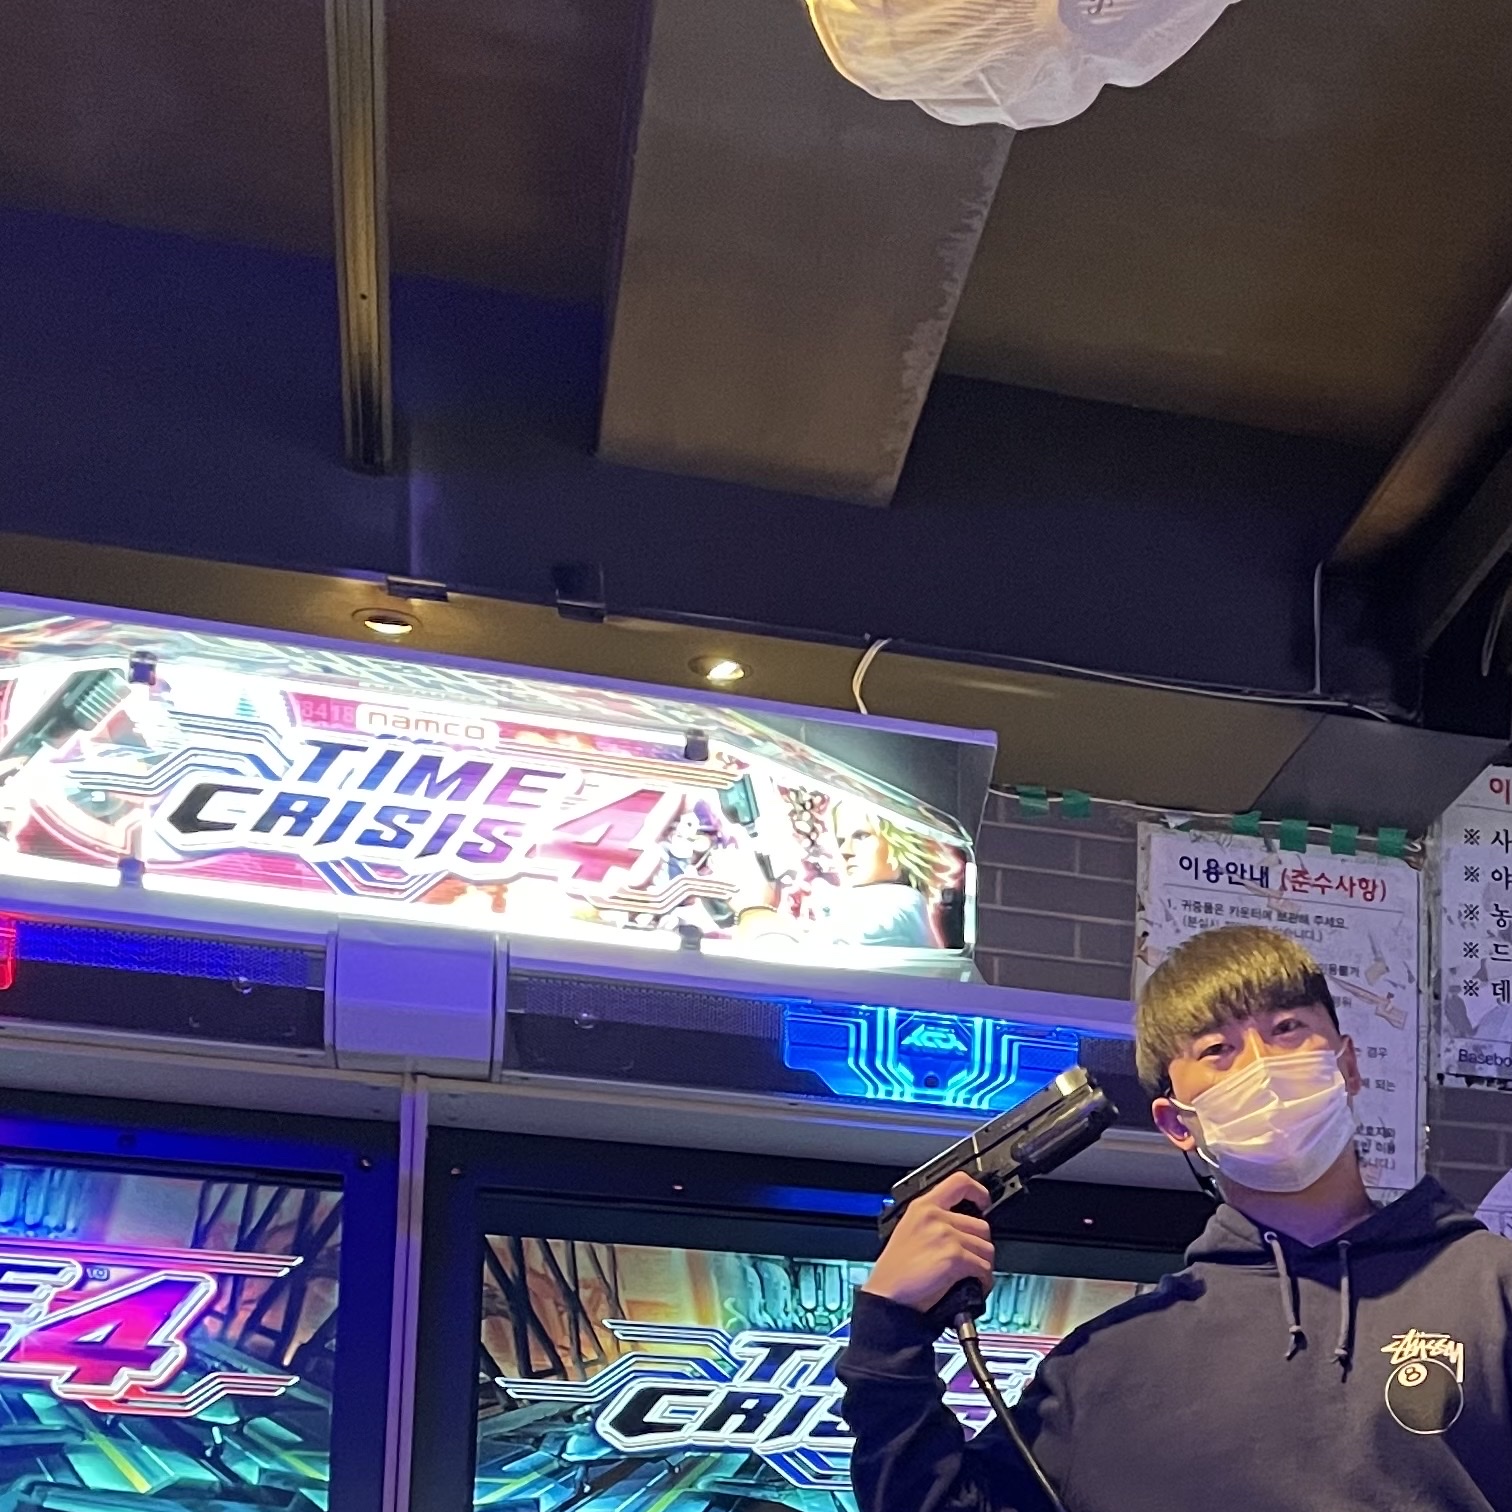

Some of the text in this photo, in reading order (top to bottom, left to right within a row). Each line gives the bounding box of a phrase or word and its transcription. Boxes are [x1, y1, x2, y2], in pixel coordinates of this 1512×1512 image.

[368, 711, 486, 740] namco
[297, 738, 567, 809] TIME
[166, 781, 669, 888] CRISIS 4
[1179, 856, 1387, 902] 이용안내 (준수사항)
[10, 1272, 216, 1397] 4
